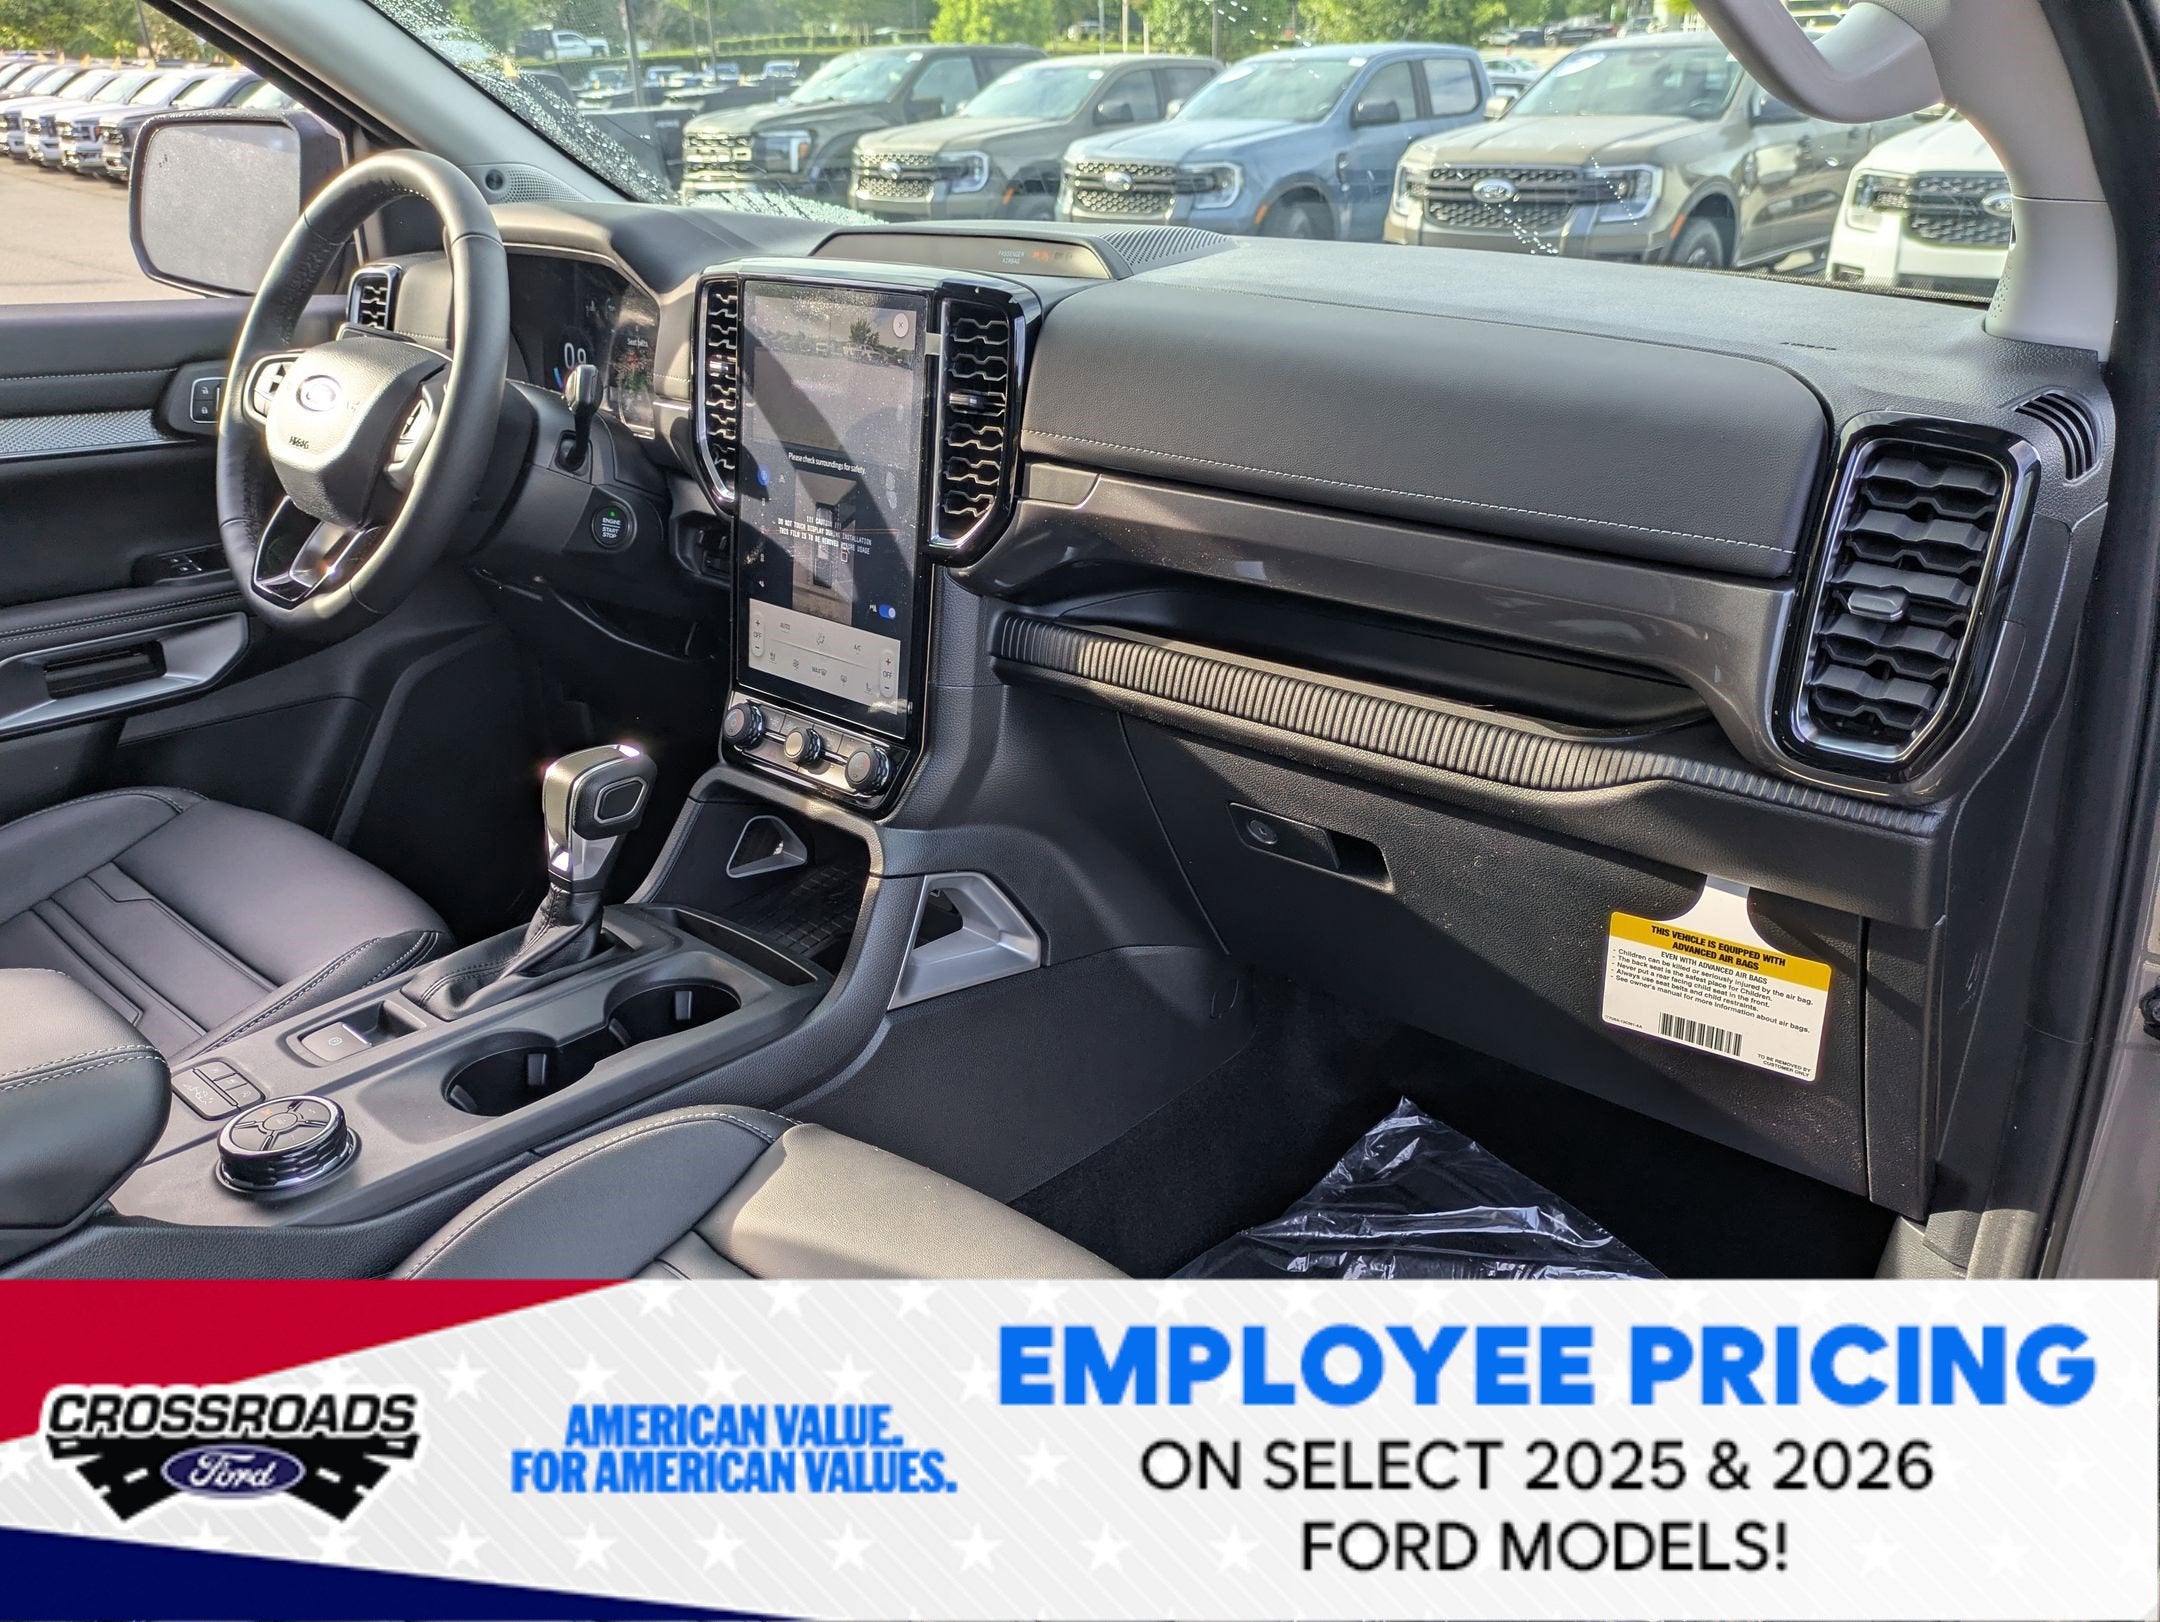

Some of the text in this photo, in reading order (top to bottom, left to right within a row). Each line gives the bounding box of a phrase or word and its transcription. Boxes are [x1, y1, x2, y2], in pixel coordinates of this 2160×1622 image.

[788, 452, 866, 475] Please check surroundings for safety.
[602, 517, 621, 525] ENGINE
[602, 526, 619, 534] START
[602, 531, 617, 539] STOP
[807, 524, 824, 534] DISPLAY
[842, 533, 872, 545] INSTALLATION
[753, 631, 762, 639] OFF
[883, 670, 892, 679] OFF
[1650, 924, 1786, 966] THIS VEHICLE IS EQUIPPED WITH
[1671, 940, 1759, 970] ADVANCED AIR BAGS
[1617, 954, 1629, 963] The
[1631, 958, 1647, 967] back
[1649, 963, 1663, 972] seat
[1672, 969, 1683, 977] the
[1685, 972, 1706, 983] safest
[1707, 978, 1727, 989] place
[1728, 984, 1738, 992] for
[1739, 987, 1772, 1001] Children.
[1618, 948, 1646, 961] Children
[1661, 959, 1670, 967] be
[1672, 962, 1690, 972] killed
[1700, 970, 1733, 984] seriously
[1734, 979, 1760, 991] injured
[1761, 986, 1771, 994] by
[1772, 989, 1784, 997] the
[1785, 992, 1796, 1000] air
[1796, 995, 1813, 1006] bag.
[1660, 951, 1767, 984] EVEN WITH ADVANCED AIR BAGS
[1616, 961, 1636, 971] Never
[1637, 967, 1649, 976] put
[1671, 976, 1692, 987] facing
[1693, 982, 1711, 991] child
[1712, 987, 1727, 996] seat
[1737, 993, 1749, 1002] the
[1750, 997, 1770, 1008] front.
[1616, 968, 1640, 980] Always
[1655, 978, 1669, 987] seat
[1671, 983, 1688, 992] belts
[1689, 988, 1703, 996] and
[1704, 991, 1721, 1001] child
[1722, 997, 1758, 1012] restraints.
[1615, 974, 1628, 983] See
[1629, 978, 1655, 990] owner's
[1657, 986, 1682, 997] manual
[1694, 997, 1712, 1006] more
[1714, 1001, 1755, 1018] information
[1756, 1013, 1777, 1024] about
[1778, 1019, 1787, 1027] air
[1788, 1022, 1810, 1034] bags.
[1762, 1059, 1809, 1077] CUSTOMER ONLY
[1774, 1058, 1802, 1070] REMOVED
